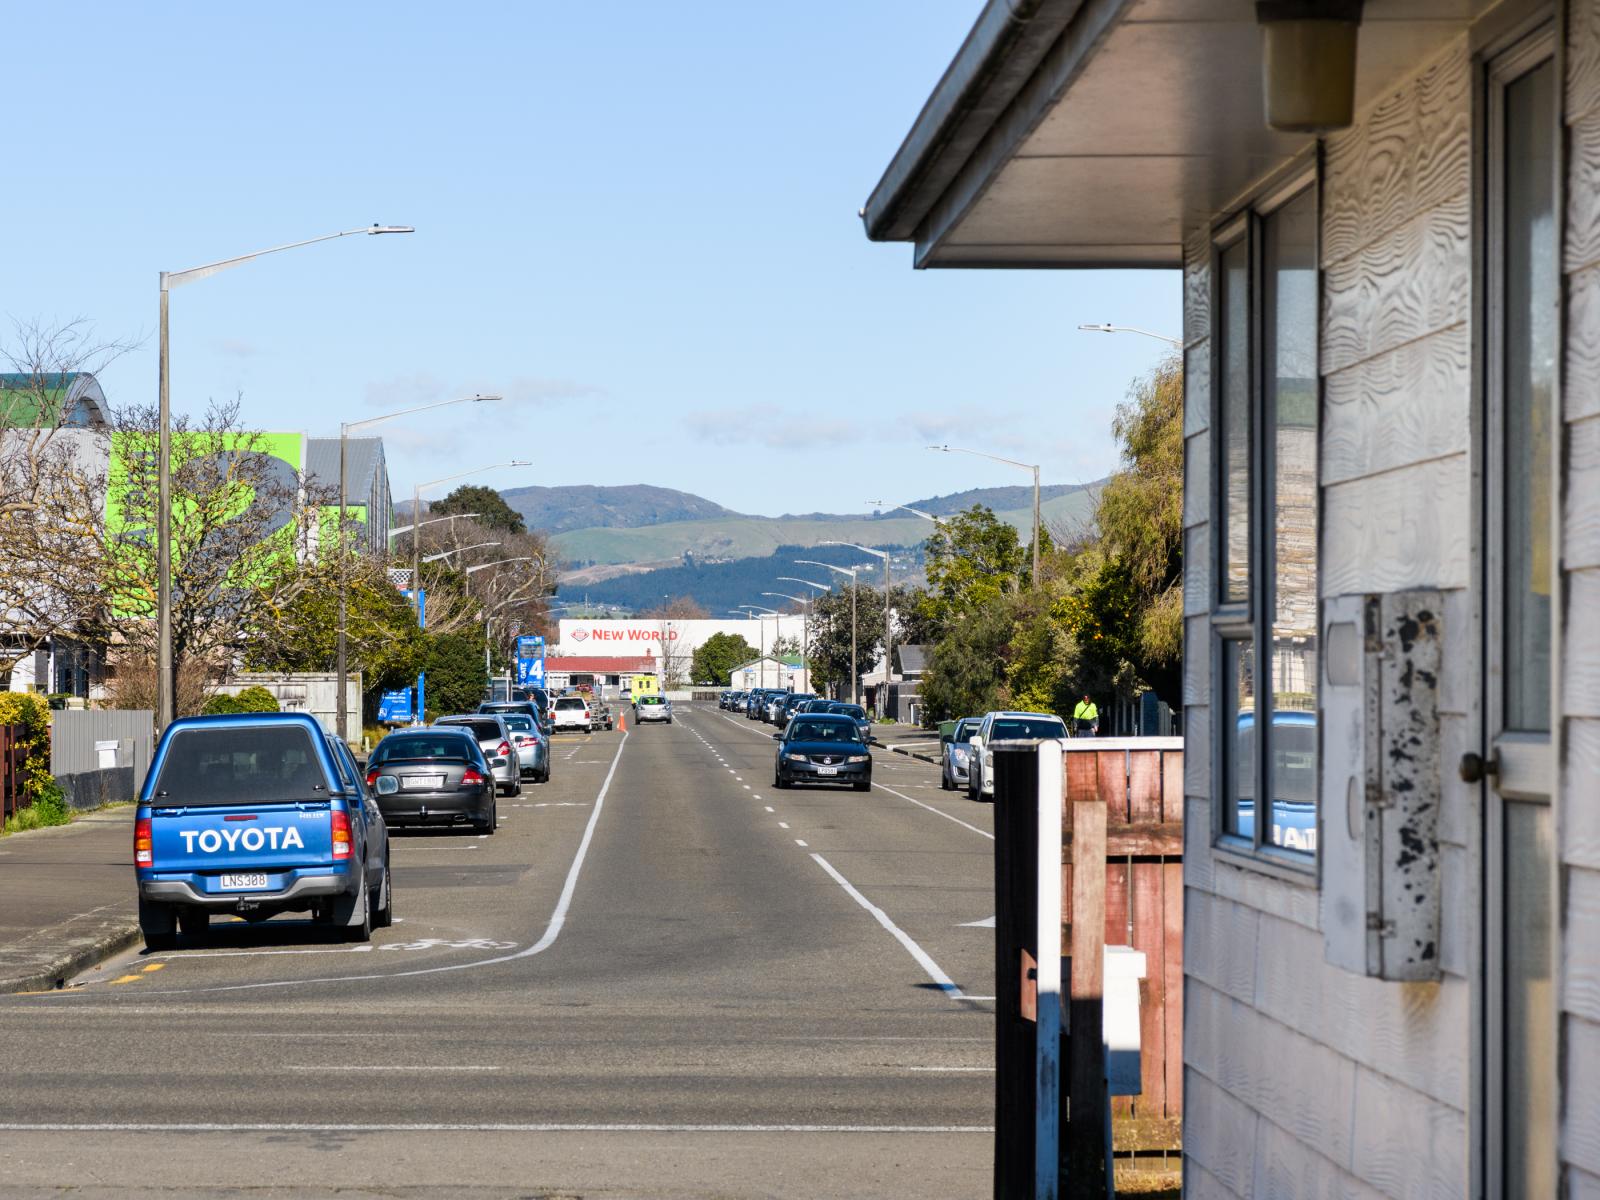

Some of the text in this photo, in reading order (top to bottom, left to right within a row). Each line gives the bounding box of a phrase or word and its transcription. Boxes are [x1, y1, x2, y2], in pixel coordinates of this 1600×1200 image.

[592, 629, 624, 641] NEW
[627, 629, 678, 641] WORLD
[529, 659, 543, 680] 4
[179, 826, 304, 853] TOYOTA
[222, 873, 266, 887] LNS308
